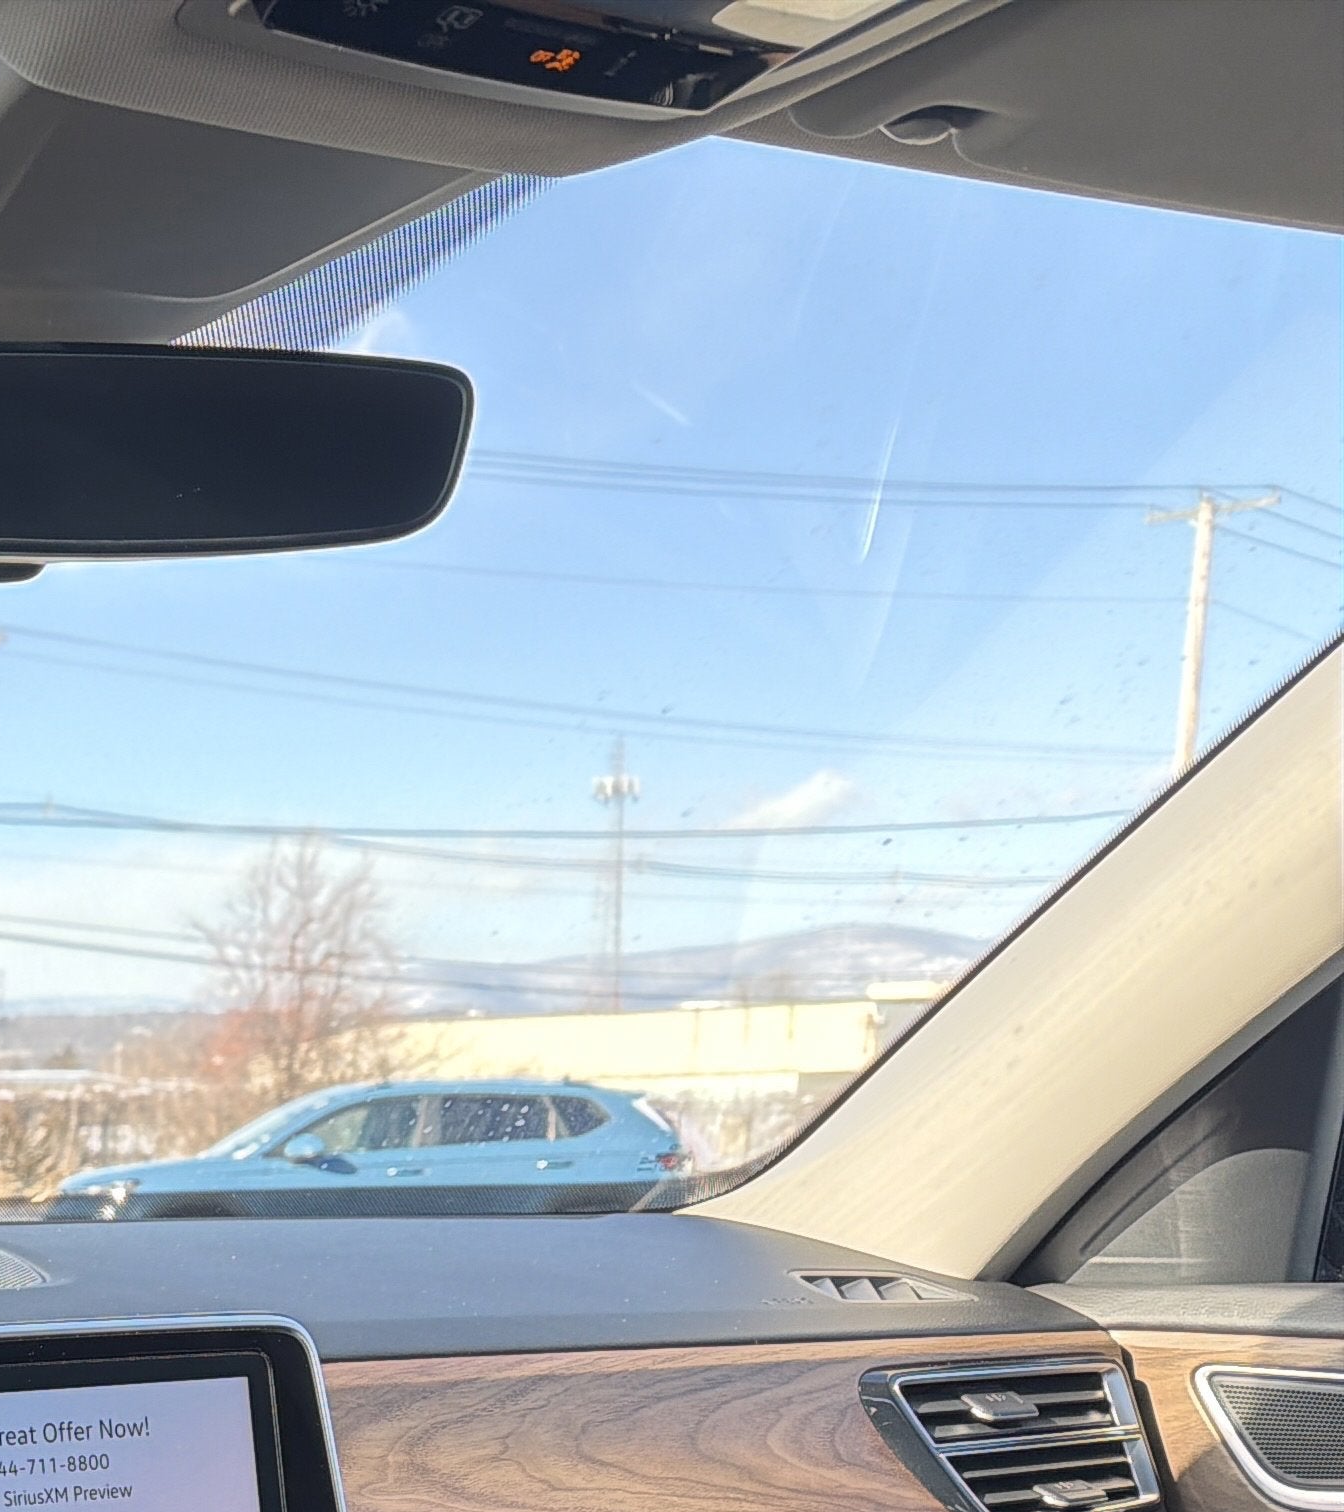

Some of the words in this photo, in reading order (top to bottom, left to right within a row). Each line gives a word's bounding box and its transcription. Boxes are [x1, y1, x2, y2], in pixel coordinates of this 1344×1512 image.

[43, 1421, 93, 1444] Offer
[99, 1416, 151, 1440] Now!
[4, 1487, 69, 1507] SiriusXM
[74, 1484, 134, 1503] Preview
